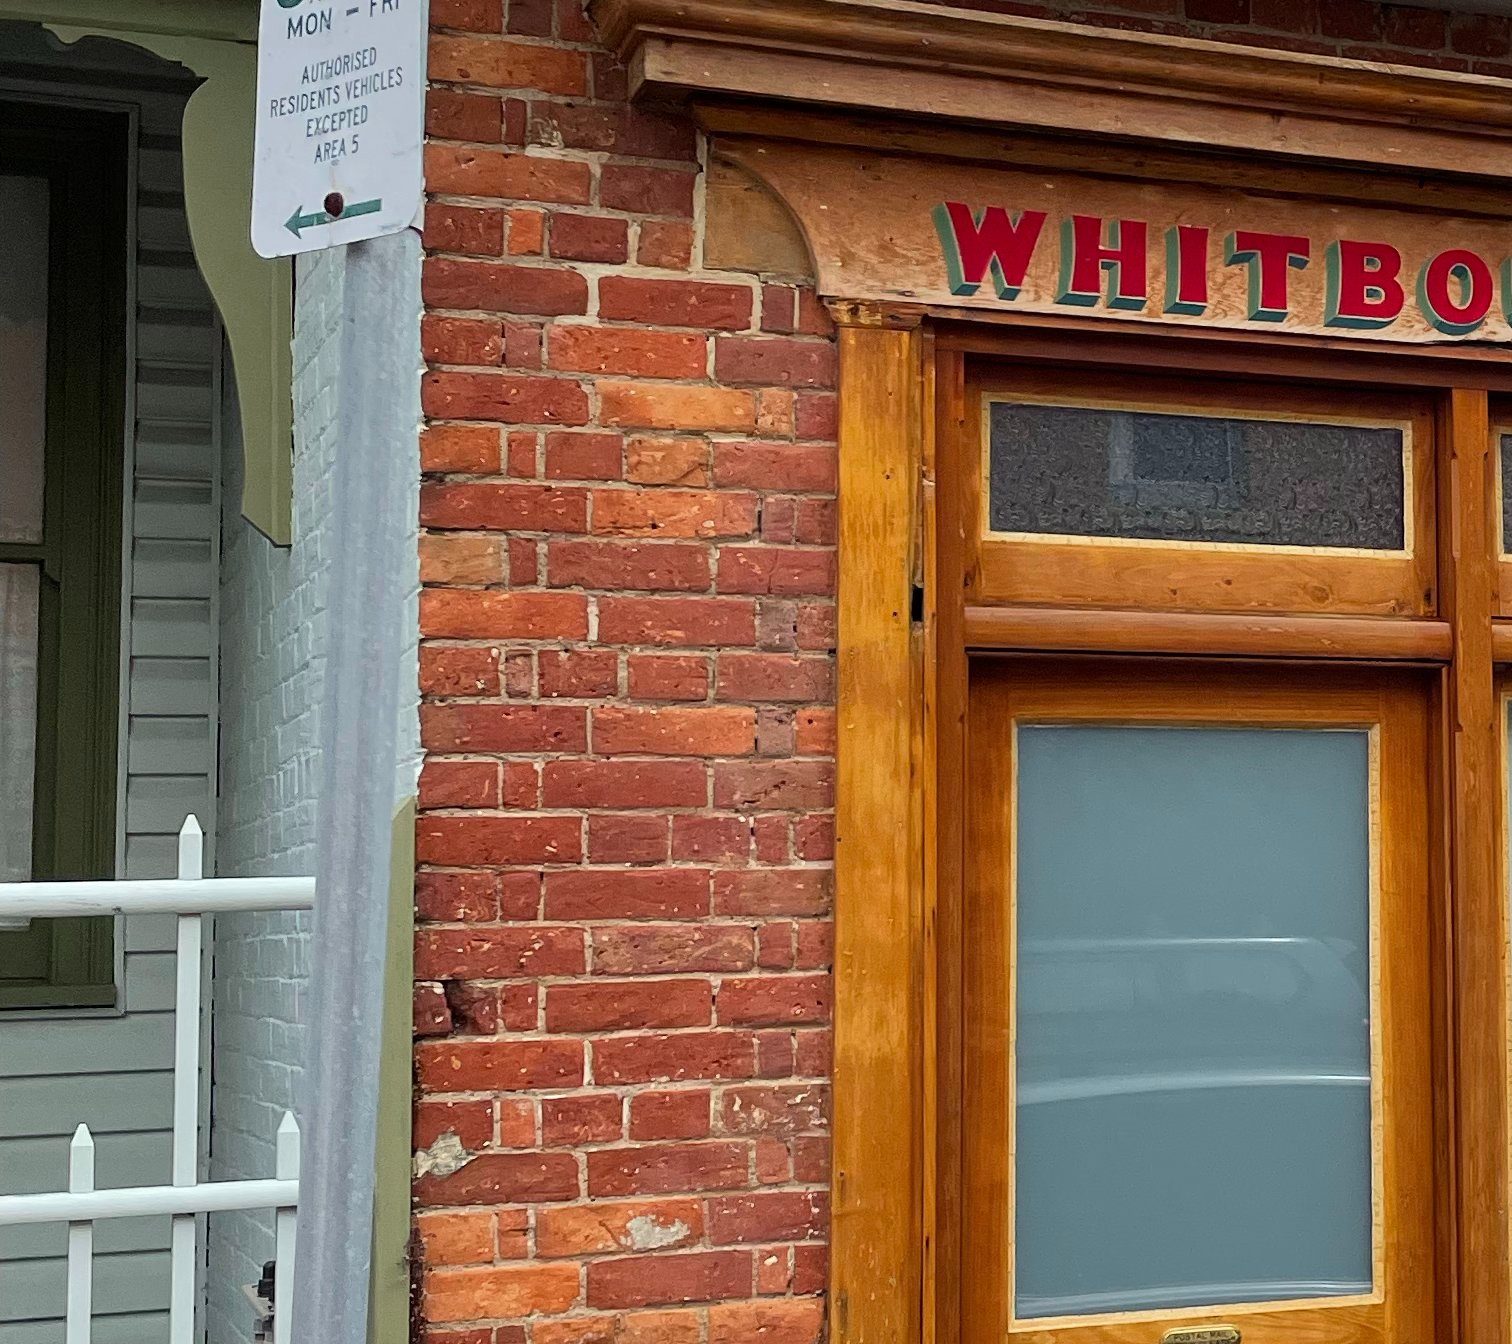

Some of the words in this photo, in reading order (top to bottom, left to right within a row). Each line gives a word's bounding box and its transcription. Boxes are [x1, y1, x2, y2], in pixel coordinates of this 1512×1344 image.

[287, 8, 332, 39] MON
[301, 46, 377, 85] AUTHORISED
[270, 85, 340, 118] RESIDENTS
[345, 66, 403, 101] VEHICLES
[306, 104, 368, 137] EXCEPTED
[314, 138, 347, 164] AREA
[351, 134, 359, 154] 5
